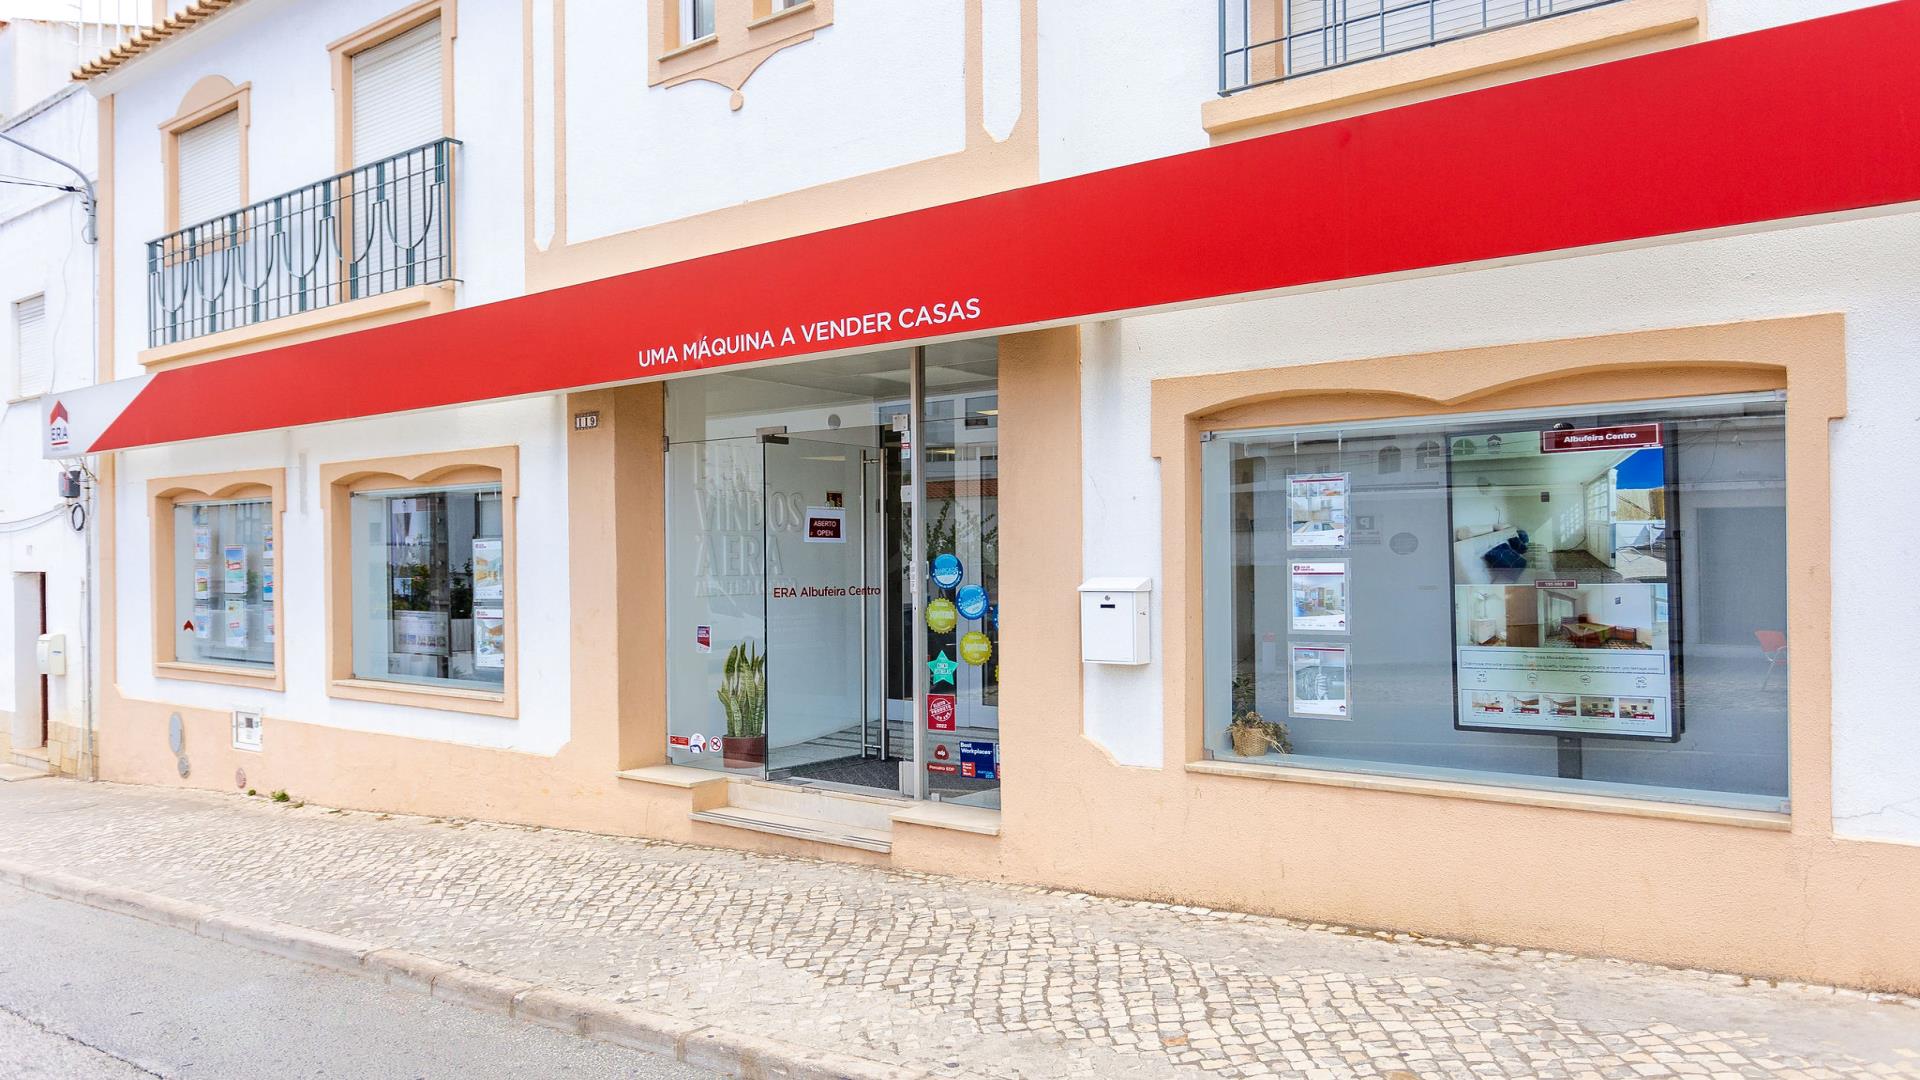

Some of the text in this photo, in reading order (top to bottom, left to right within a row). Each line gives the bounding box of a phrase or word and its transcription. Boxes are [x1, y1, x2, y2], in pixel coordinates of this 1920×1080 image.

[638, 297, 982, 368] UMA MÁQUINA A VENDER CASAS
[51, 426, 68, 440] ERA
[1563, 432, 1637, 443] Albufeira Centro
[773, 587, 797, 598] ERA
[800, 585, 846, 598] Albufeira
[848, 585, 881, 596] Centro
